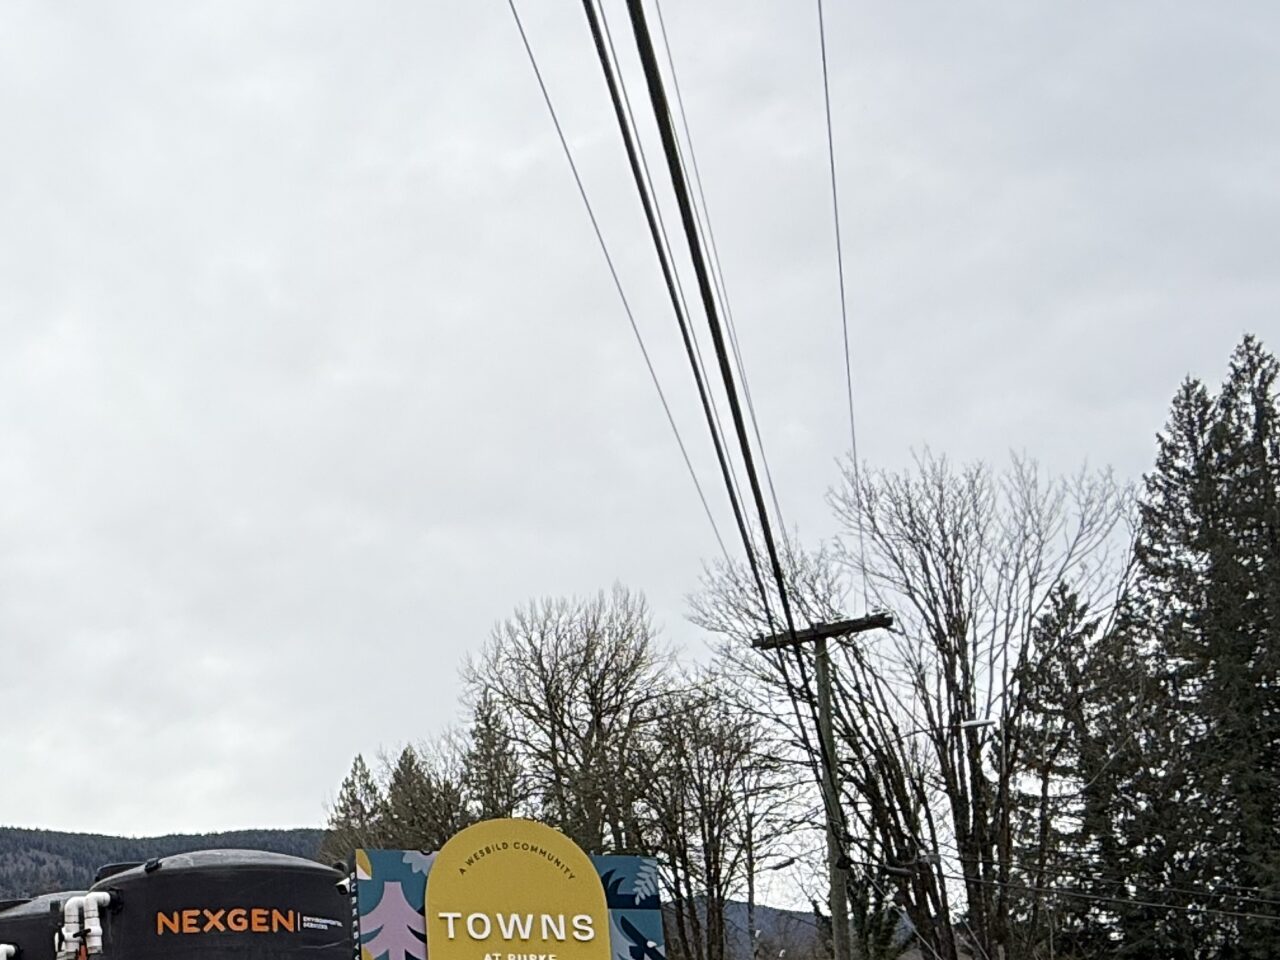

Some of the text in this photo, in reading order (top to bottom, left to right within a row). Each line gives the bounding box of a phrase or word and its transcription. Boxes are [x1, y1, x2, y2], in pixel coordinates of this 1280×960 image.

[465, 842, 508, 867] WESBILD
[513, 842, 576, 880] COMMUNITY
[157, 908, 294, 935] NEXGEN
[438, 912, 595, 941] TOWNS
